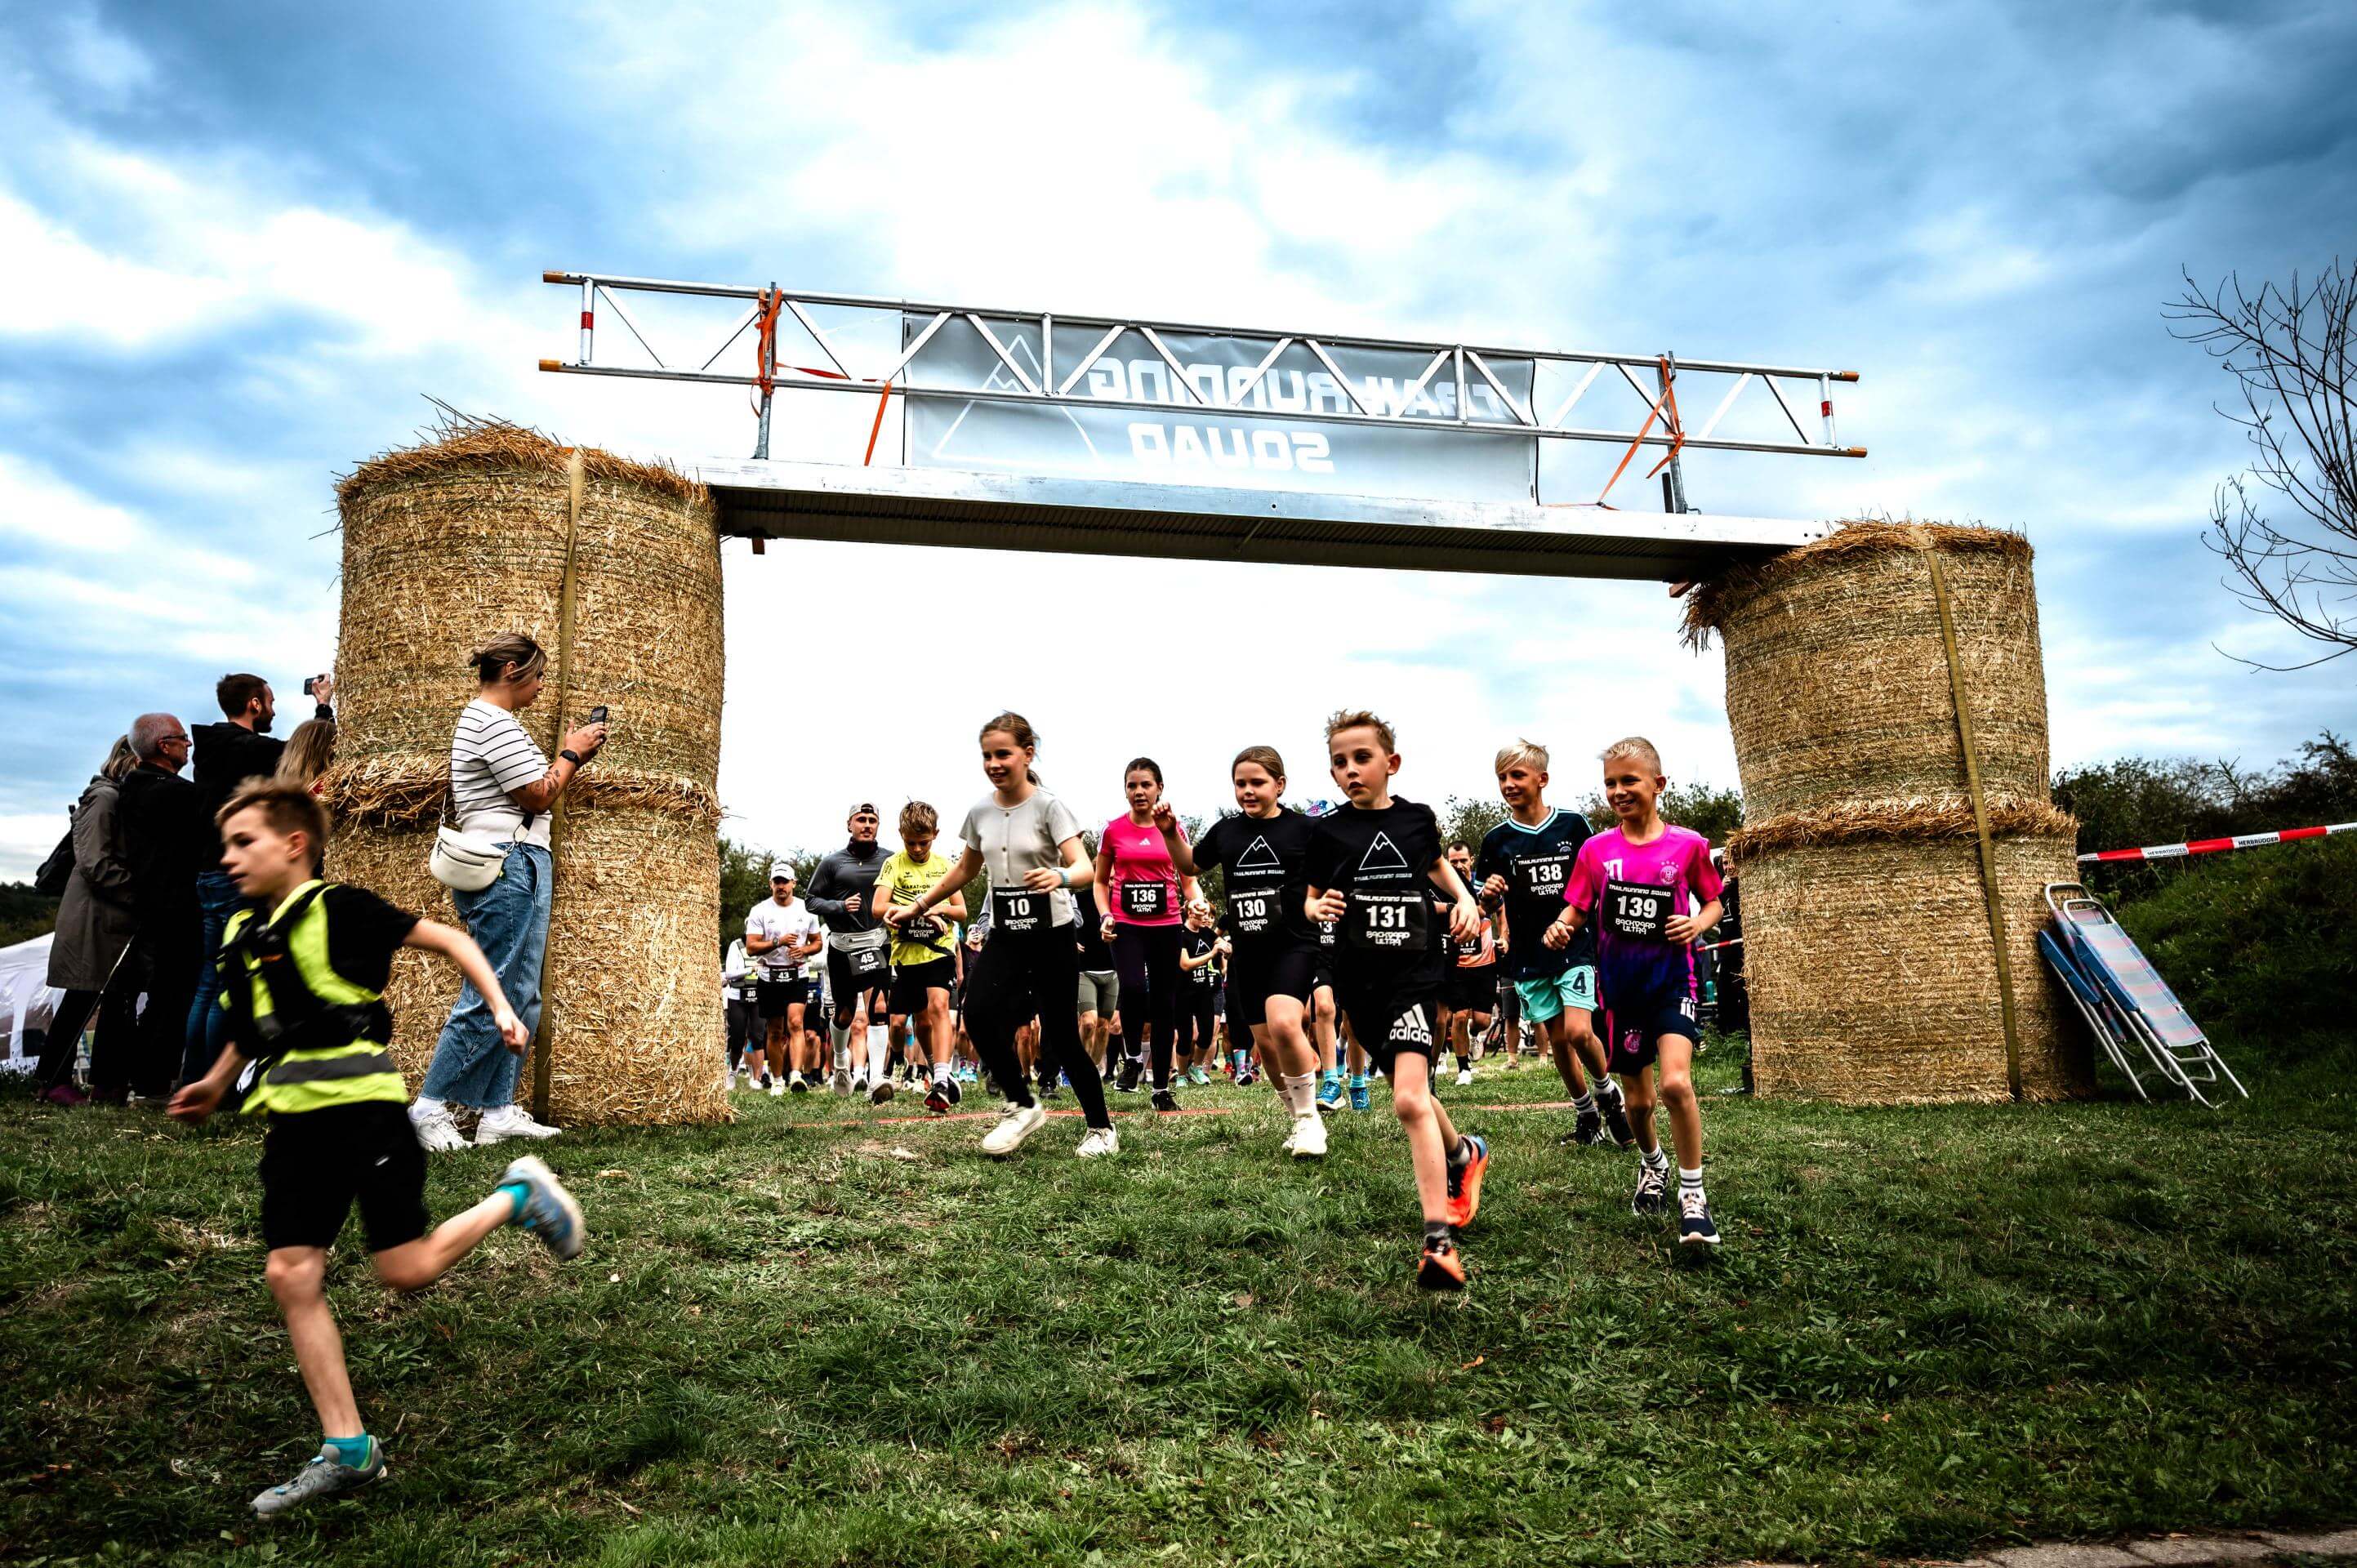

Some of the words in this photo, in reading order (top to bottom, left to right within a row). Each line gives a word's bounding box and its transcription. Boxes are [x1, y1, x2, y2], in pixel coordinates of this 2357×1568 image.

[1529, 864, 1563, 883] 138
[1131, 889, 1156, 902] 136
[1609, 884, 1650, 895] TRAILRUNNING
[1007, 898, 1030, 916] 10
[1236, 899, 1266, 918] 130
[1617, 896, 1657, 919] 139
[1366, 905, 1406, 928] 131
[1623, 925, 1647, 935] ULTRA
[861, 951, 875, 964] 45
[778, 971, 790, 979] 43
[1192, 969, 1205, 978] 141
[1572, 971, 1587, 994] 4
